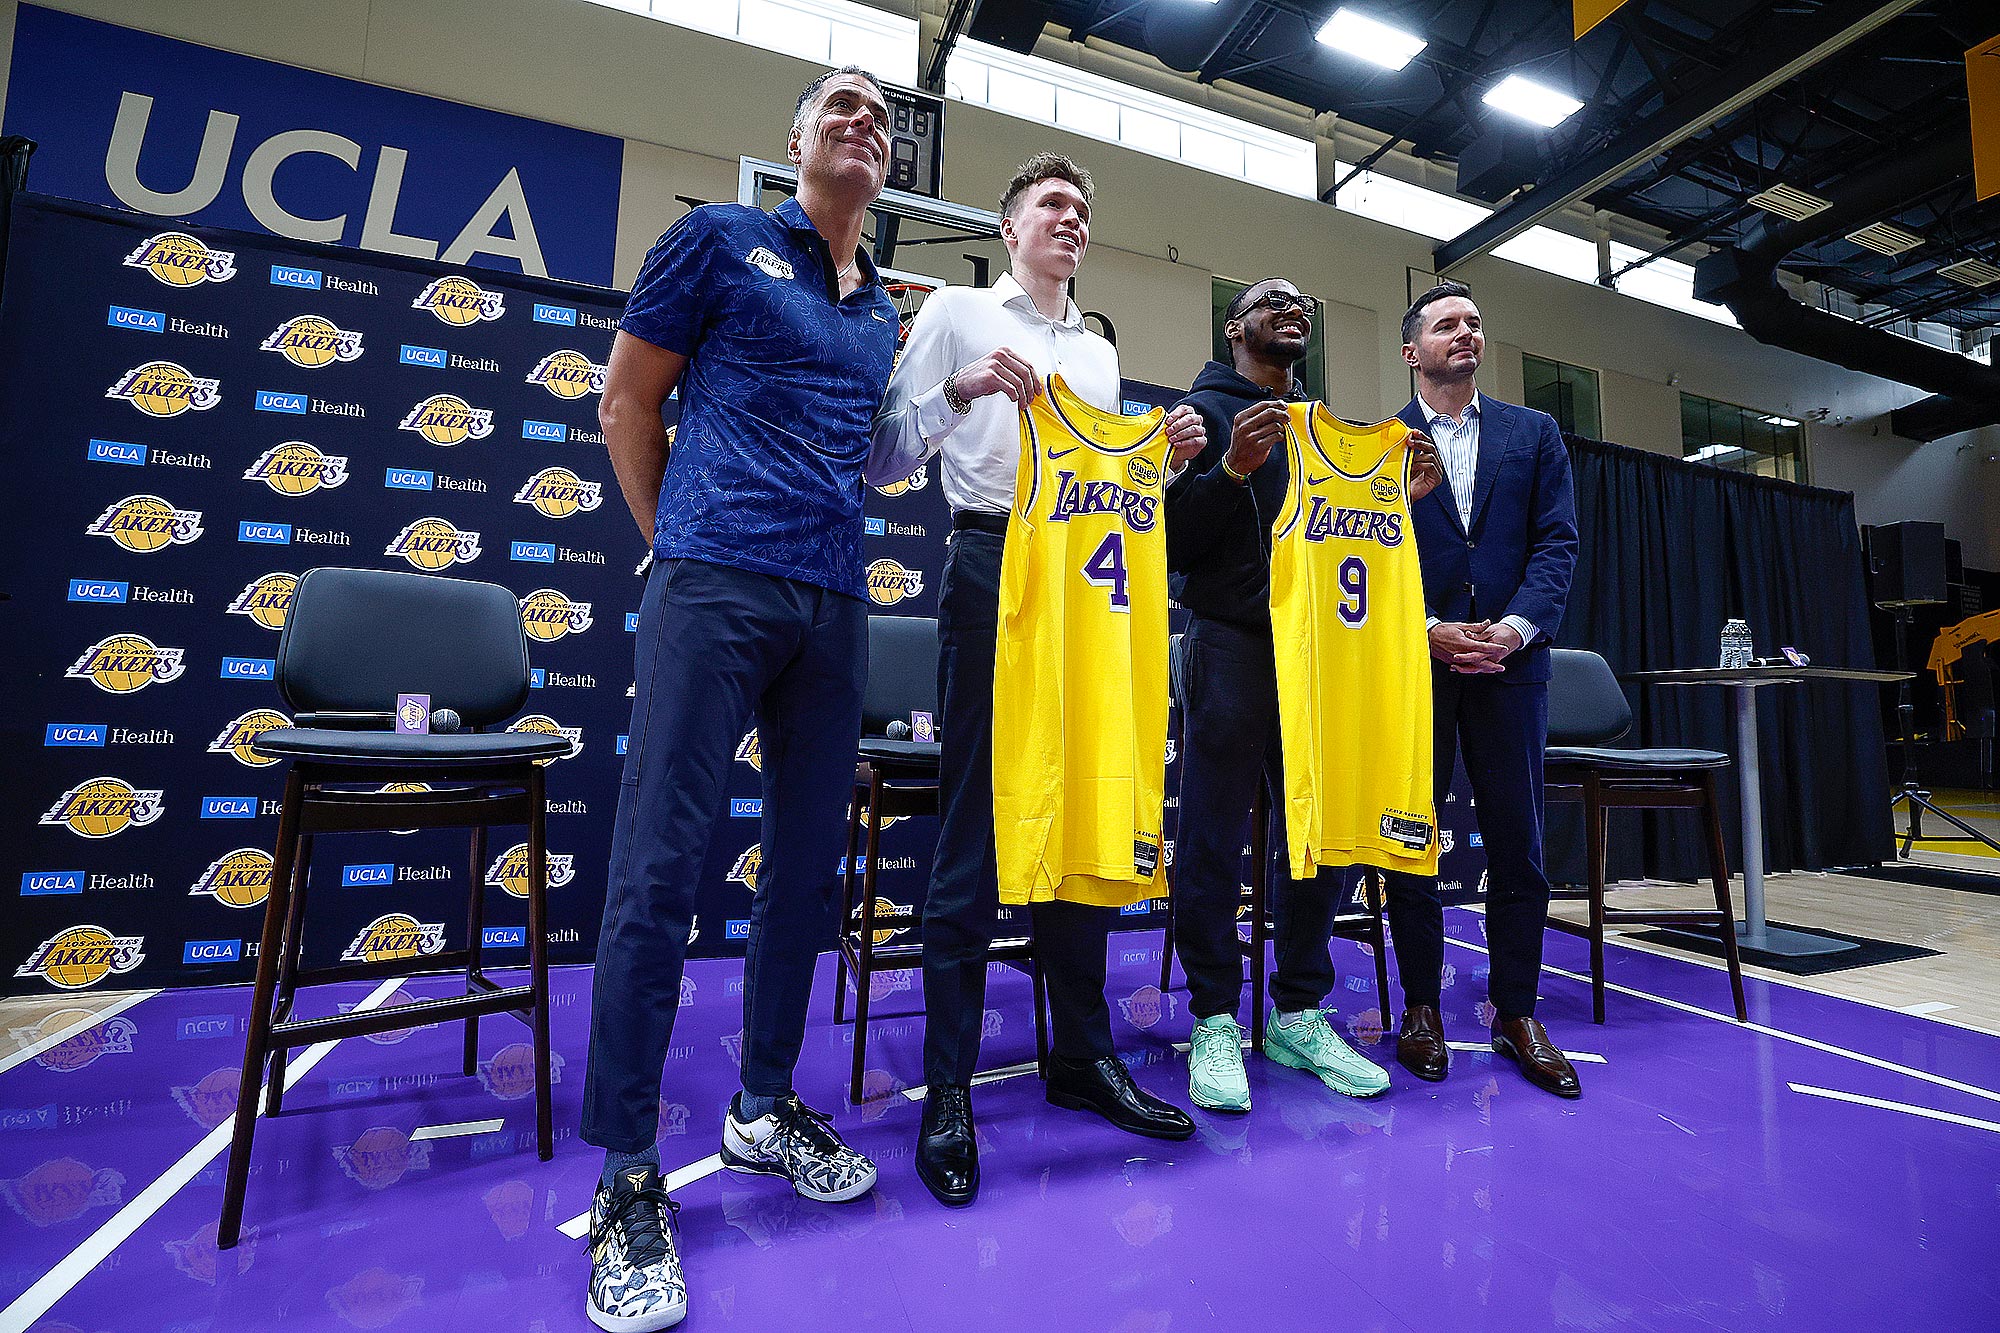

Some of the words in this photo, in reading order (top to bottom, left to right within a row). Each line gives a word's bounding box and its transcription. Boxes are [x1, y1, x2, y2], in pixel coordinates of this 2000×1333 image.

[105, 92, 548, 279] UCLA
[134, 241, 231, 278] LAKERS
[184, 248, 230, 260] ANGELES
[278, 270, 314, 284] UCLA
[326, 276, 378, 296] Health
[421, 285, 500, 317] LAKERS
[461, 290, 500, 300] ANGELES
[116, 312, 158, 328] UCLA
[168, 318, 228, 338] Health
[540, 308, 570, 322] UCLA
[270, 325, 359, 358] LAKERS
[316, 330, 359, 339] ANGELES
[406, 350, 440, 364] UCLA
[450, 354, 500, 372] Health
[572, 364, 608, 372] ANGELES
[168, 377, 215, 387] ANGELES
[534, 360, 608, 390] LAKERS
[116, 372, 215, 406] LAKERS
[262, 396, 300, 410] UCLA
[310, 398, 366, 418] Health
[450, 409, 489, 417] ANGELES
[1126, 404, 1148, 414] UCLA
[408, 405, 489, 435] LAKERS
[528, 424, 560, 438] UCLA
[96, 444, 138, 460] UCLA
[150, 450, 212, 468] Health
[253, 453, 343, 484] LAKERS
[1130, 461, 1157, 480] bibigo
[392, 472, 426, 486] UCLA
[436, 476, 488, 492] Health
[522, 478, 598, 508] LAKERS
[1048, 470, 1158, 532] LAKERS
[97, 507, 198, 540] LAKERS
[150, 511, 198, 519] ANGELES
[1304, 496, 1404, 548] LAKERS
[246, 526, 284, 540] UCLA
[294, 528, 350, 546] Health
[888, 522, 926, 536] Health
[394, 529, 476, 559] LAKERS
[516, 546, 550, 558] UCLA
[558, 548, 606, 564] Health
[1082, 532, 1129, 610] 4
[76, 584, 120, 598] UCLA
[132, 586, 194, 604] Health
[1338, 555, 1368, 628] 9
[76, 648, 179, 679] LAKERS
[228, 662, 268, 674] UCLA
[548, 672, 596, 688] Health
[54, 728, 98, 742] UCLA
[110, 728, 174, 744] Health
[51, 793, 158, 822] LAKERS
[210, 802, 250, 814] UCLA
[878, 856, 916, 870] Health
[30, 876, 76, 890] UCLA
[88, 874, 154, 890] Health
[200, 864, 272, 892] LAKE
[350, 868, 386, 882] UCLA
[398, 866, 450, 880] Health
[350, 929, 440, 957] LAKERS
[484, 932, 518, 942] UCLA
[27, 942, 139, 973] LAKERS
[192, 946, 232, 958] UCLA
